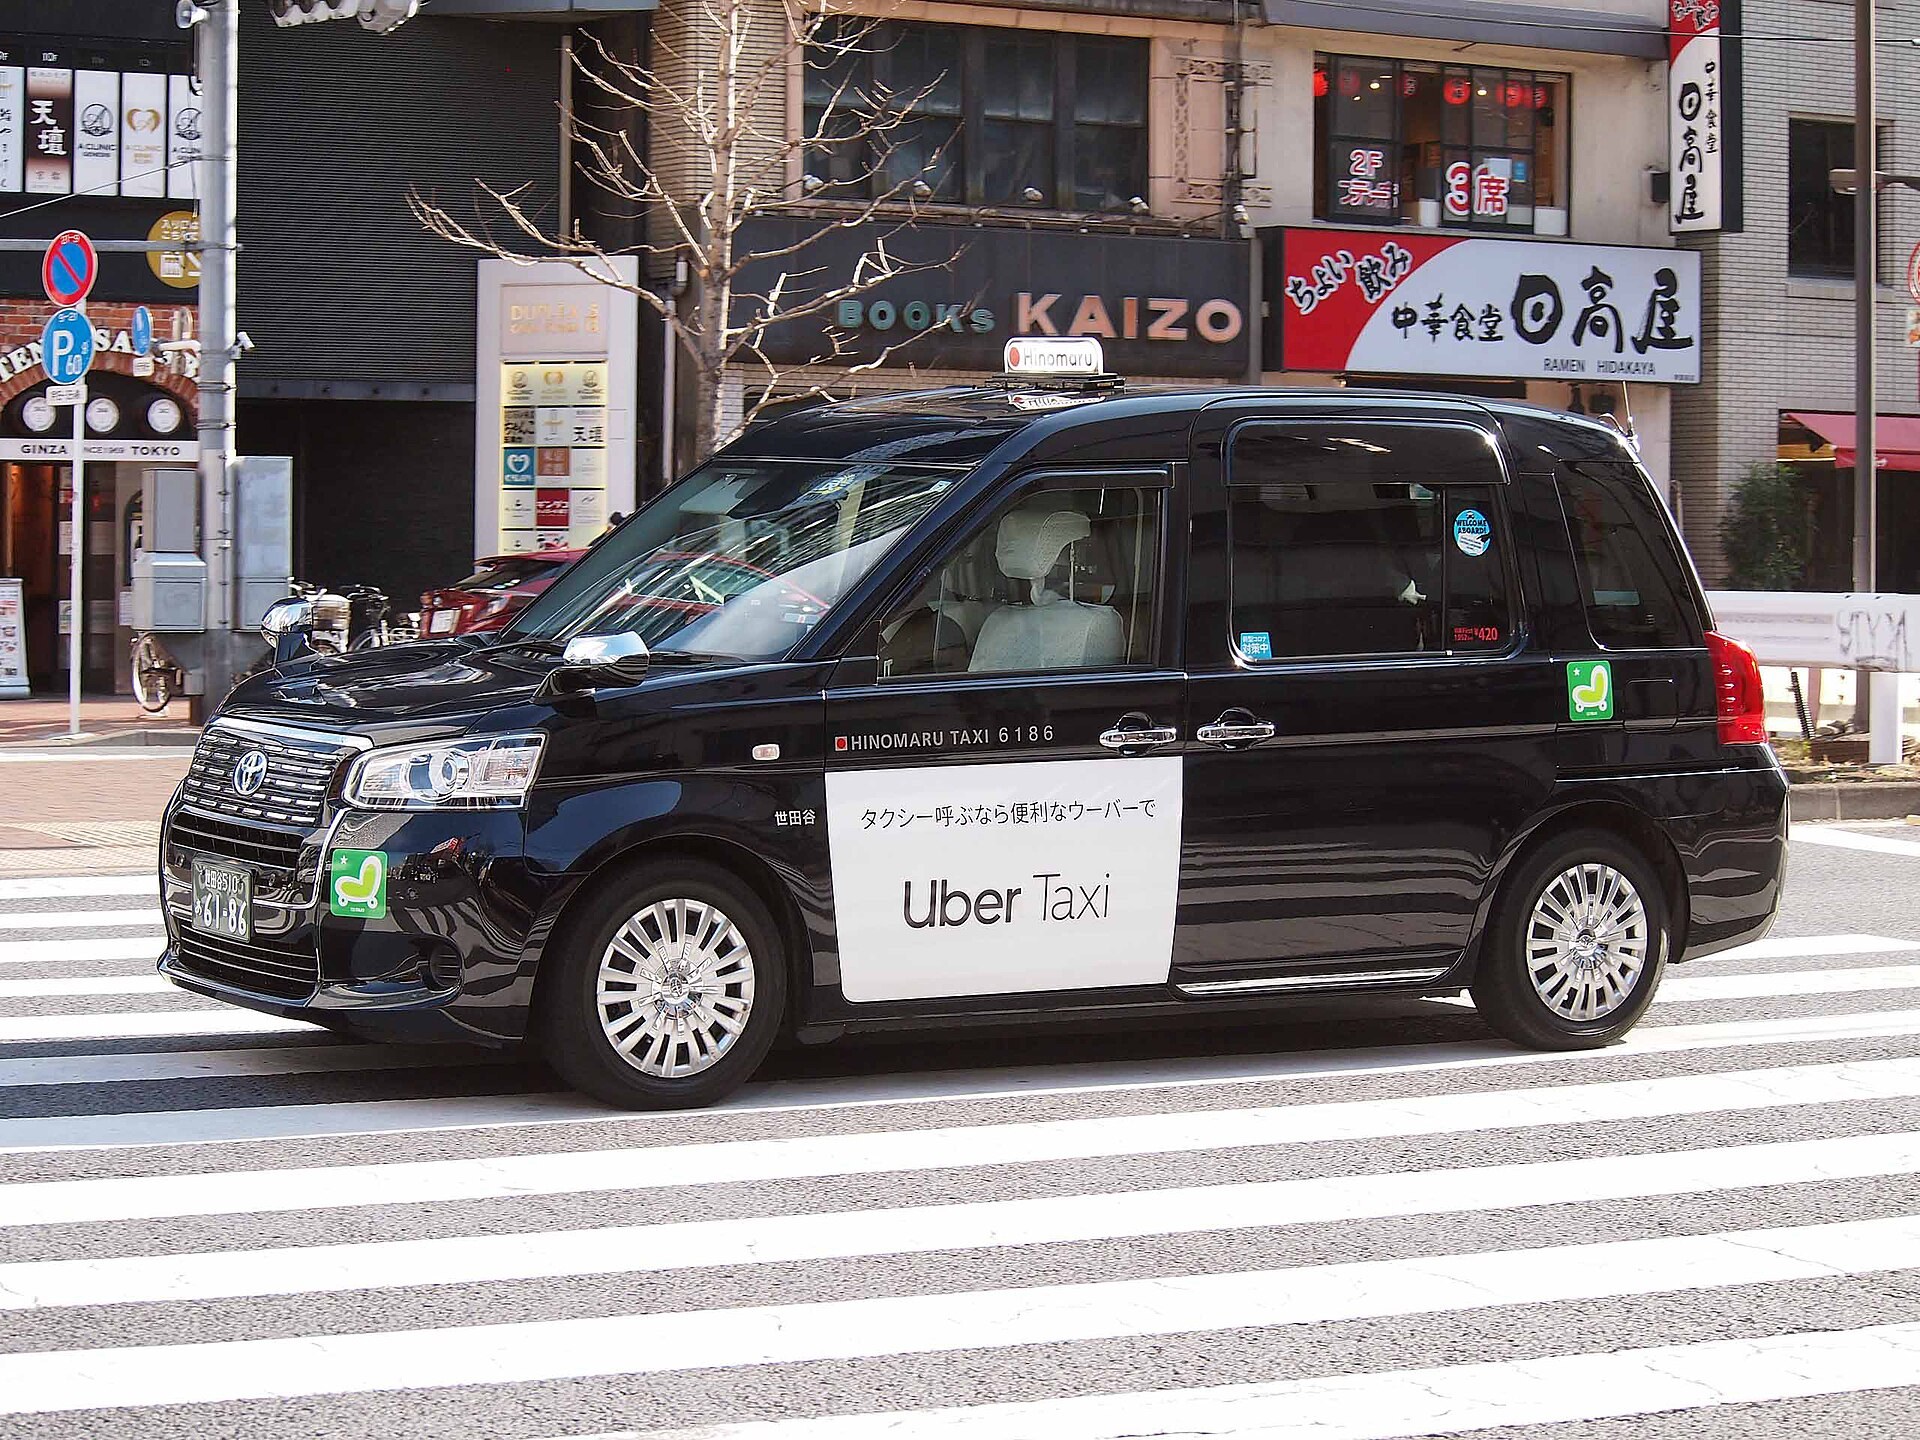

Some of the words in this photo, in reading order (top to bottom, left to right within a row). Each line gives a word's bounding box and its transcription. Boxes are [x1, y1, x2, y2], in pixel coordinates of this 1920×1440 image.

[30, 100, 67, 155] 天壇
[1350, 150, 1383, 178] 2F
[1675, 82, 1704, 224] 日高屋
[1286, 242, 1413, 314] ちょい飲み
[1017, 292, 1242, 343] KAIZO
[1392, 294, 1504, 342] 中華食堂
[1511, 266, 1694, 354] 日高屋
[52, 330, 74, 376] P
[66, 354, 82, 375] 60
[1023, 347, 1092, 366] Hinomaru
[1543, 358, 1585, 372] RAMEN
[1596, 360, 1656, 375] HIDAKAYA
[20, 444, 68, 454] GINZA
[131, 446, 180, 456] TOKYO
[851, 730, 944, 751] HINOMARU
[950, 728, 990, 748] TAXI
[999, 725, 1054, 743] 6186
[775, 809, 816, 827] 世田谷
[860, 799, 1158, 830] タクシー呼ぶなら便利なウーバーで
[902, 878, 1021, 929] Uber
[1032, 873, 1111, 922] Taxi
